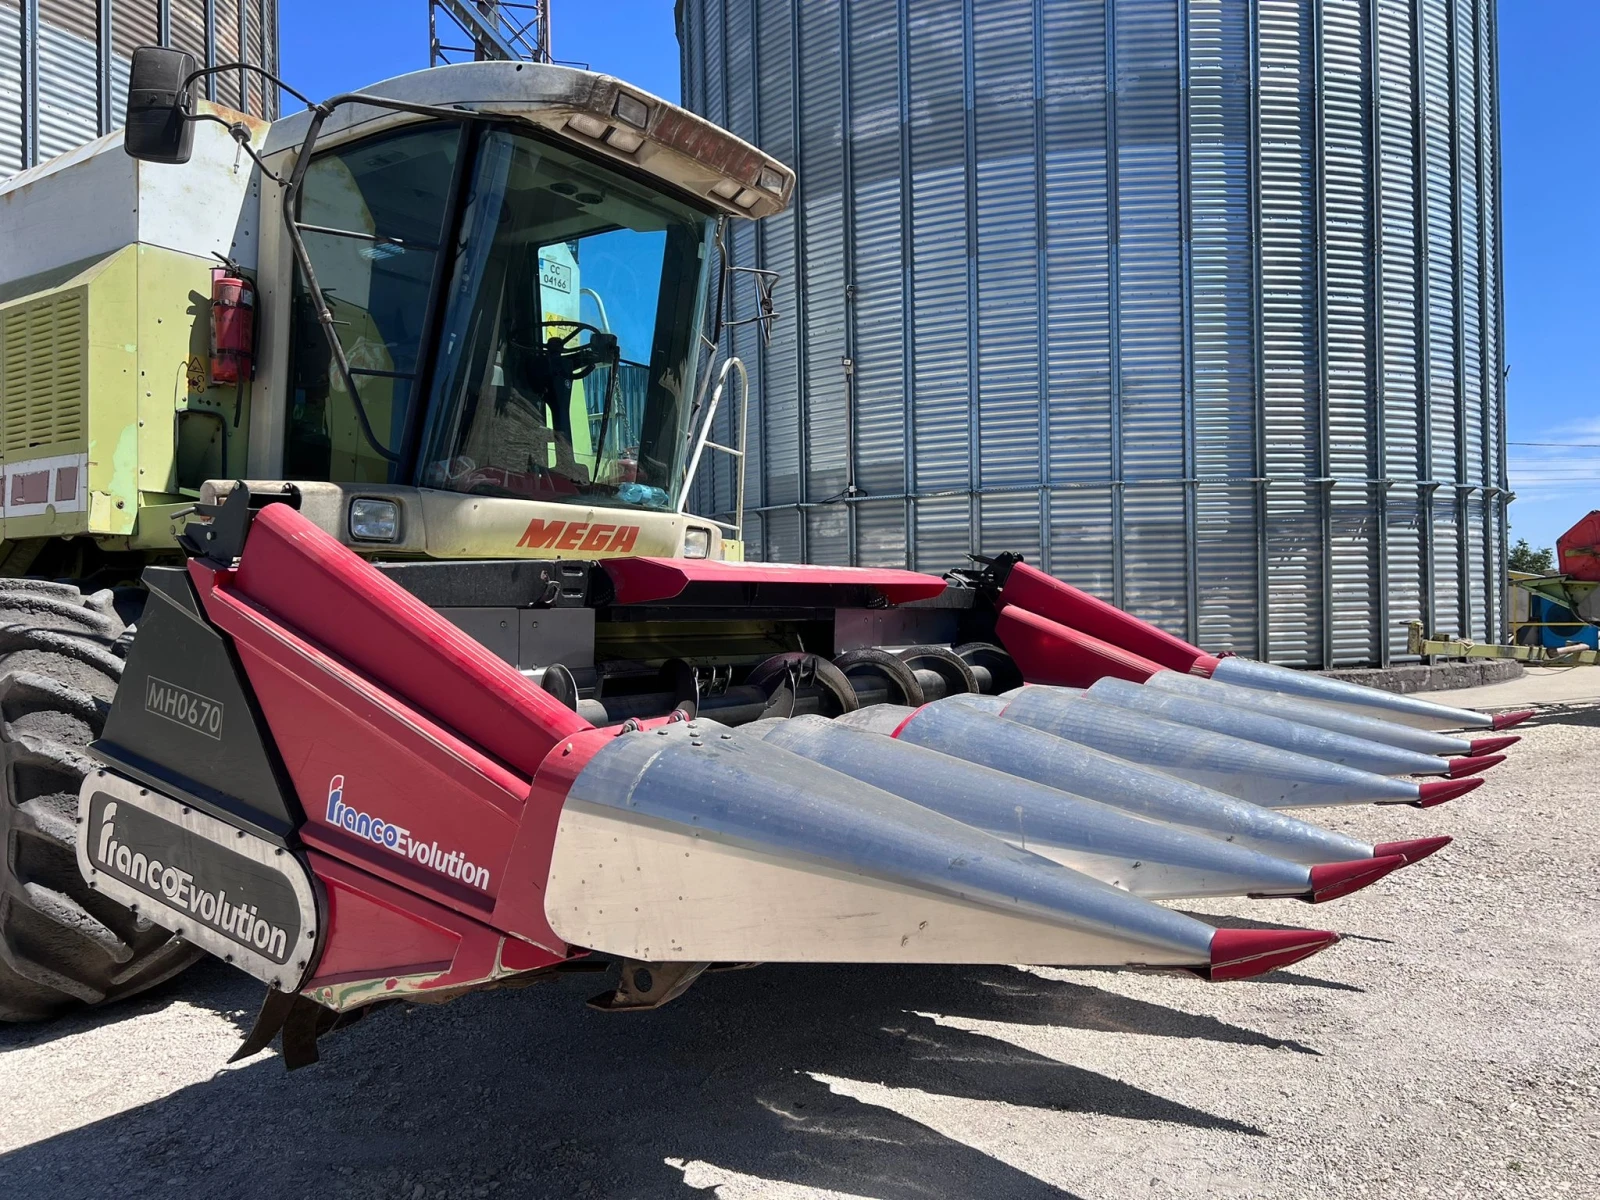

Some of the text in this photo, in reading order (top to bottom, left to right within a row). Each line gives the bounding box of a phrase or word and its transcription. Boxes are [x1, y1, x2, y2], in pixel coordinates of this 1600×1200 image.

[544, 274, 566, 289] 04166
[550, 264, 560, 275] CC
[516, 518, 640, 552] MEGA
[147, 682, 221, 733] MH0670
